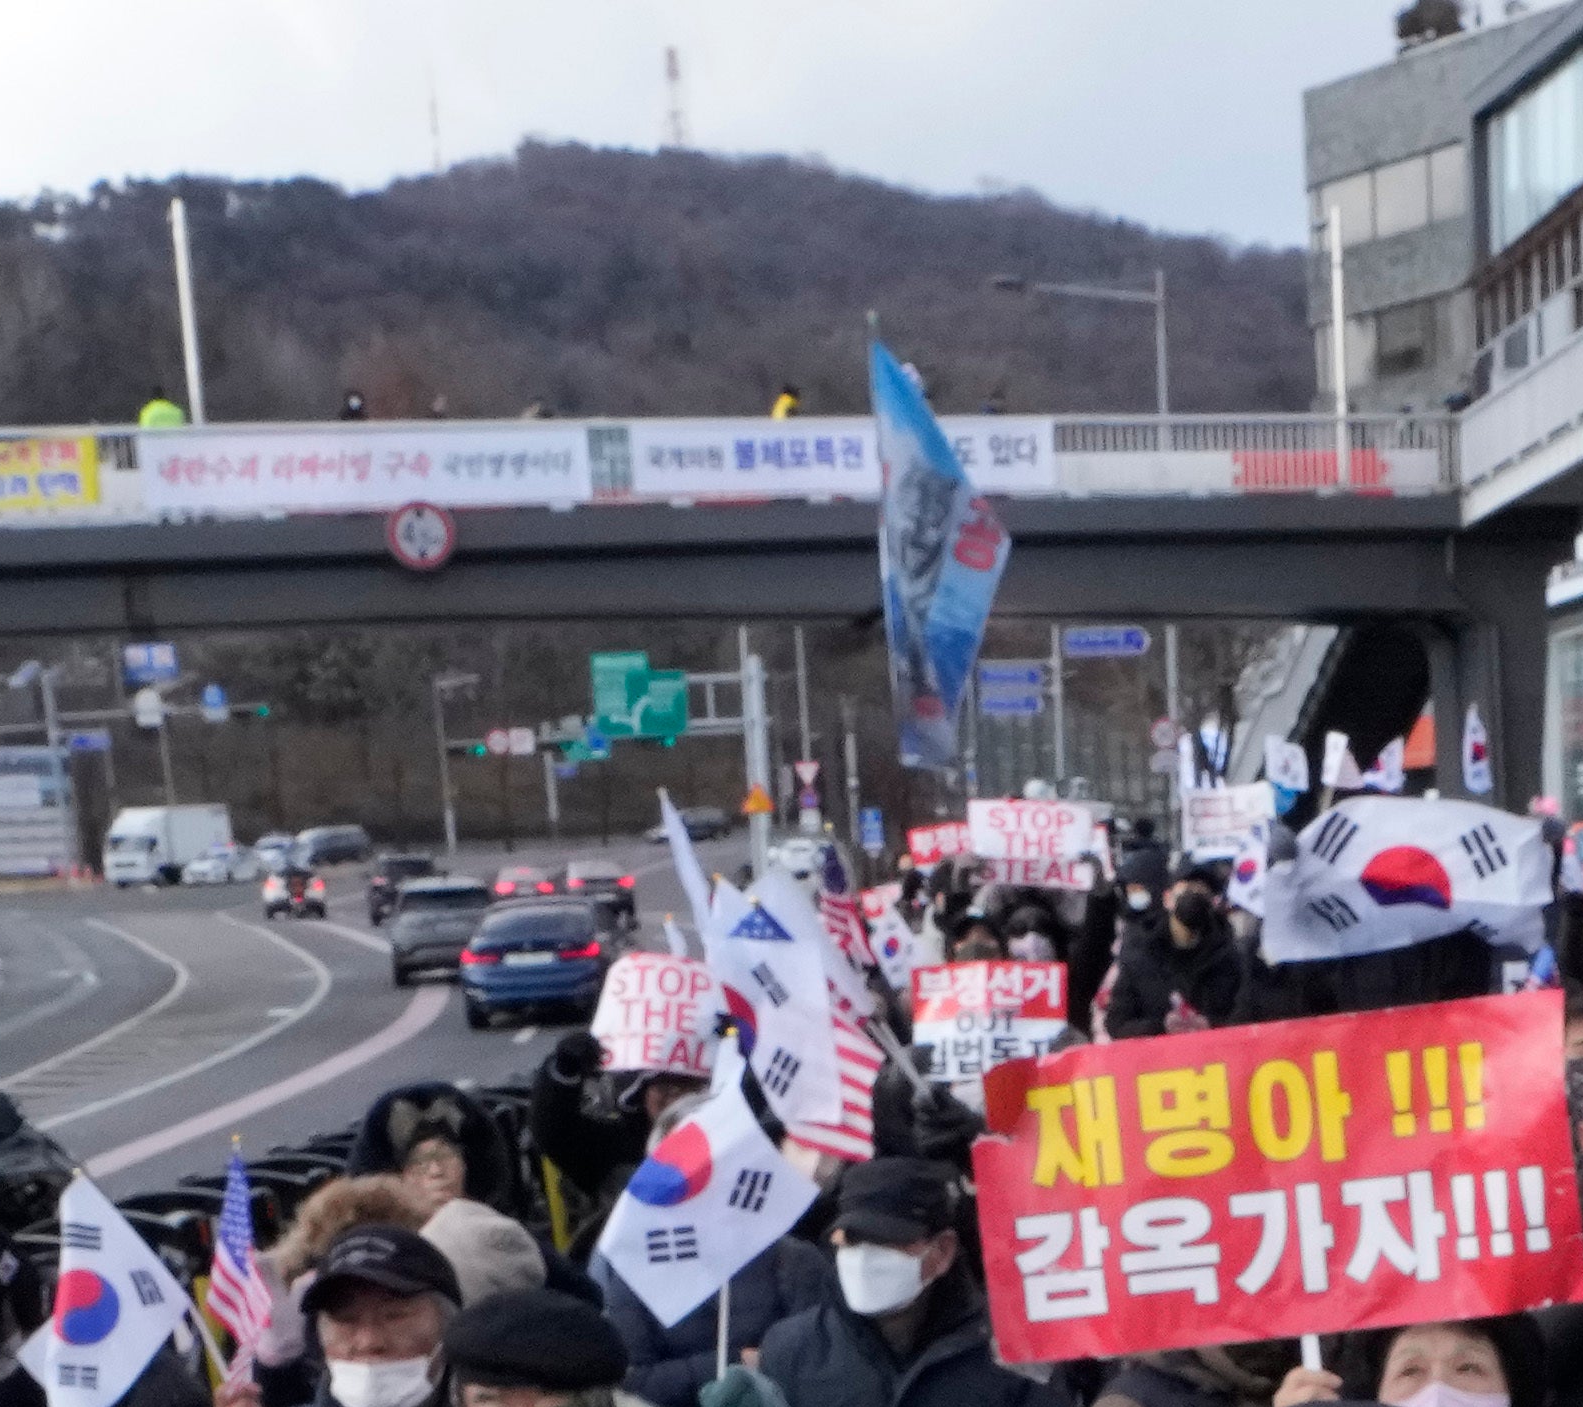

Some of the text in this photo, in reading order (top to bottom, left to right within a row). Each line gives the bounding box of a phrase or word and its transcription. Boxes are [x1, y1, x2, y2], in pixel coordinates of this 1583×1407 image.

[988, 806, 1076, 830] STOP
[1004, 830, 1065, 857] THE
[979, 858, 1081, 884] STEAL
[612, 964, 712, 999] STOP
[919, 966, 1061, 1009] 부정선거
[619, 999, 698, 1036] THE
[599, 1032, 711, 1073] STEAL
[1026, 1041, 1487, 1190] 재명아 !!!
[1013, 1165, 1553, 1323] 감옥가자!!!
